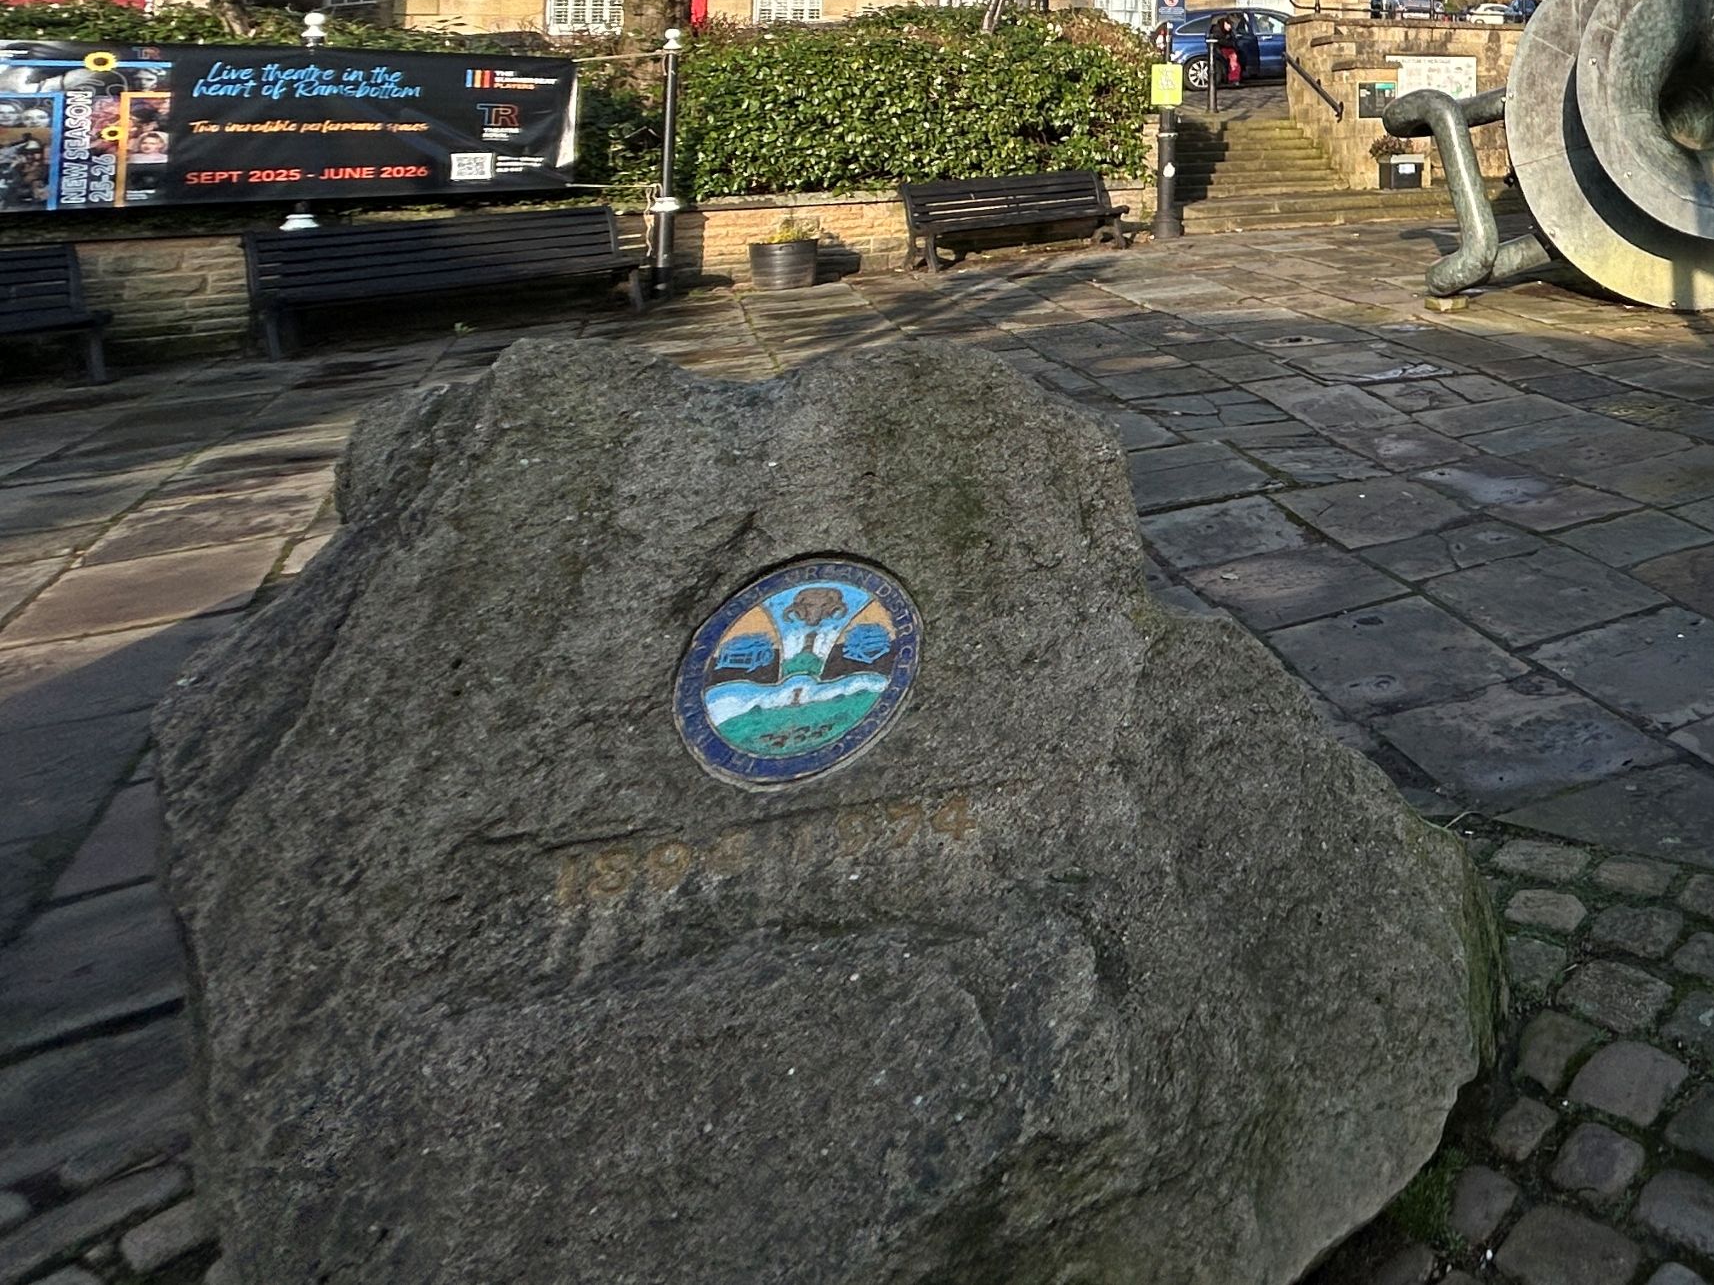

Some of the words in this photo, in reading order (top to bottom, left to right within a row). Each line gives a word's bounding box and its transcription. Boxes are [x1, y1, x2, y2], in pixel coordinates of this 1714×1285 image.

[206, 61, 254, 83] Live
[261, 63, 334, 82] theatre
[342, 67, 363, 82] in
[371, 65, 404, 83] the
[192, 78, 257, 98] heart
[260, 80, 287, 99] of
[294, 79, 422, 100] Ramsbottom
[63, 90, 94, 160] SEASON
[188, 120, 220, 133] Two
[224, 119, 298, 133] incredible
[299, 119, 383, 134] performance
[61, 162, 89, 204] NEW
[184, 170, 243, 185] SEPT
[248, 168, 301, 182] 2025
[319, 166, 377, 180] JUNE
[379, 165, 429, 179] 2026
